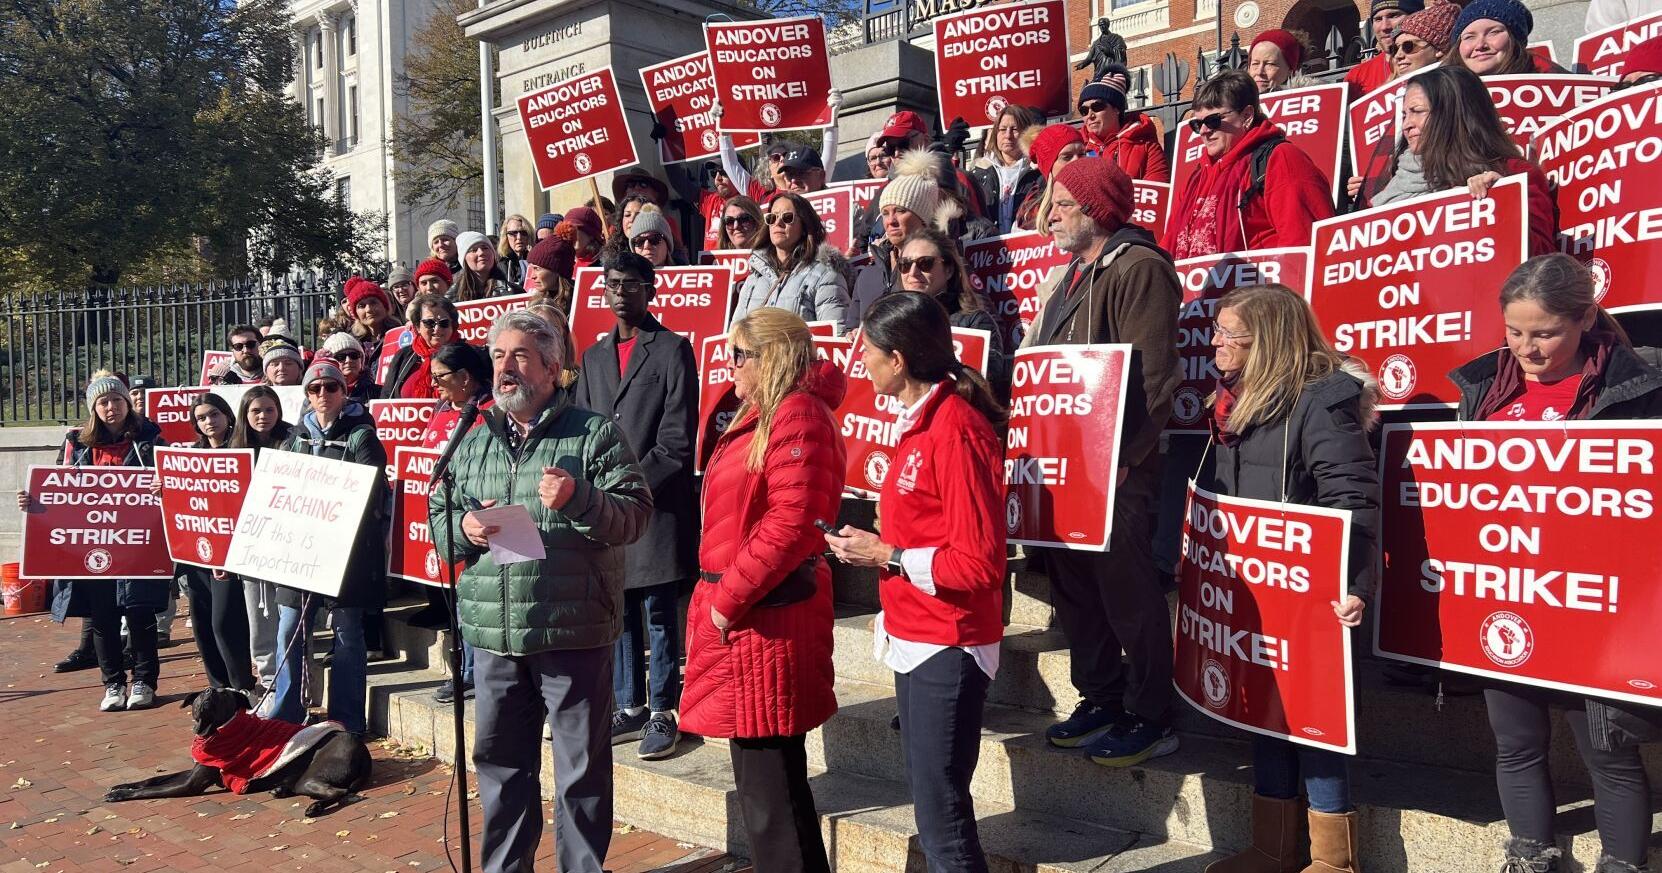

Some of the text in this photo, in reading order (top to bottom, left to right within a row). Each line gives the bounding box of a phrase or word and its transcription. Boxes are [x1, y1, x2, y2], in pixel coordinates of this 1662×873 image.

[522, 21, 583, 53] BULFINCH
[715, 24, 810, 46] ANDOVER
[943, 6, 1049, 40] ANDOVER
[716, 45, 812, 63] EDUCATORS
[944, 28, 1051, 58] EDUCATORS
[653, 57, 709, 86] ANDOV
[751, 66, 776, 79] ON
[980, 54, 1008, 71] ON
[523, 62, 586, 92] ENTRANCE
[656, 76, 715, 102] EDUCATO
[731, 81, 808, 101] STRIKE!
[955, 69, 1041, 97] STRIKE!
[527, 76, 603, 113] ANDOVER
[690, 95, 710, 109] ON
[1487, 84, 1611, 109] DOVE
[529, 93, 608, 128] EDUCATORS
[674, 111, 715, 133] STRI
[562, 119, 582, 134] ON
[545, 127, 609, 158] STRIKE!
[1545, 136, 1662, 191] DUCATO
[1578, 180, 1622, 213] ON
[1326, 197, 1496, 255] ANDOVER
[1557, 207, 1662, 255] TRIKE
[971, 250, 993, 268] We
[996, 241, 1055, 267] Support
[1323, 237, 1495, 287] EDUCATORS
[590, 273, 713, 289] AOVER
[986, 266, 1055, 293] NDOV
[1177, 261, 1281, 291] OVER
[587, 294, 711, 309] EATORS
[1378, 282, 1420, 309] ON
[457, 301, 529, 324] NDOVE
[1334, 310, 1472, 352] STRIKE!
[379, 406, 434, 423] ANDO
[1009, 393, 1093, 419] ATORS
[841, 412, 900, 448] STRI
[1007, 426, 1028, 449] ON
[162, 455, 239, 474] ANDOVER
[1401, 437, 1654, 475] ANDOVER
[42, 472, 157, 488] ANDOVE
[164, 476, 240, 493] EDUCATORS
[260, 452, 272, 473] I
[273, 460, 304, 479] would
[305, 464, 339, 486] rather
[343, 470, 360, 493] be
[1003, 457, 1068, 485] RIKE!
[39, 492, 162, 506] EDUCATORS
[189, 496, 209, 511] ON
[268, 485, 343, 522] TEACHING
[1400, 481, 1654, 519] EDUCATORS
[86, 510, 118, 523] ON
[175, 513, 235, 535] STRIKE!
[1186, 497, 1313, 555] ANDOVER
[50, 528, 151, 545] STRIKE!
[241, 513, 314, 550] BUT this is
[1478, 523, 1541, 555] ON
[236, 545, 321, 579] Important
[1182, 532, 1310, 593] EDUCATORS
[1201, 581, 1233, 614] ON
[1420, 558, 1619, 613] STRIKE!
[1181, 603, 1289, 671] STRIKE!
